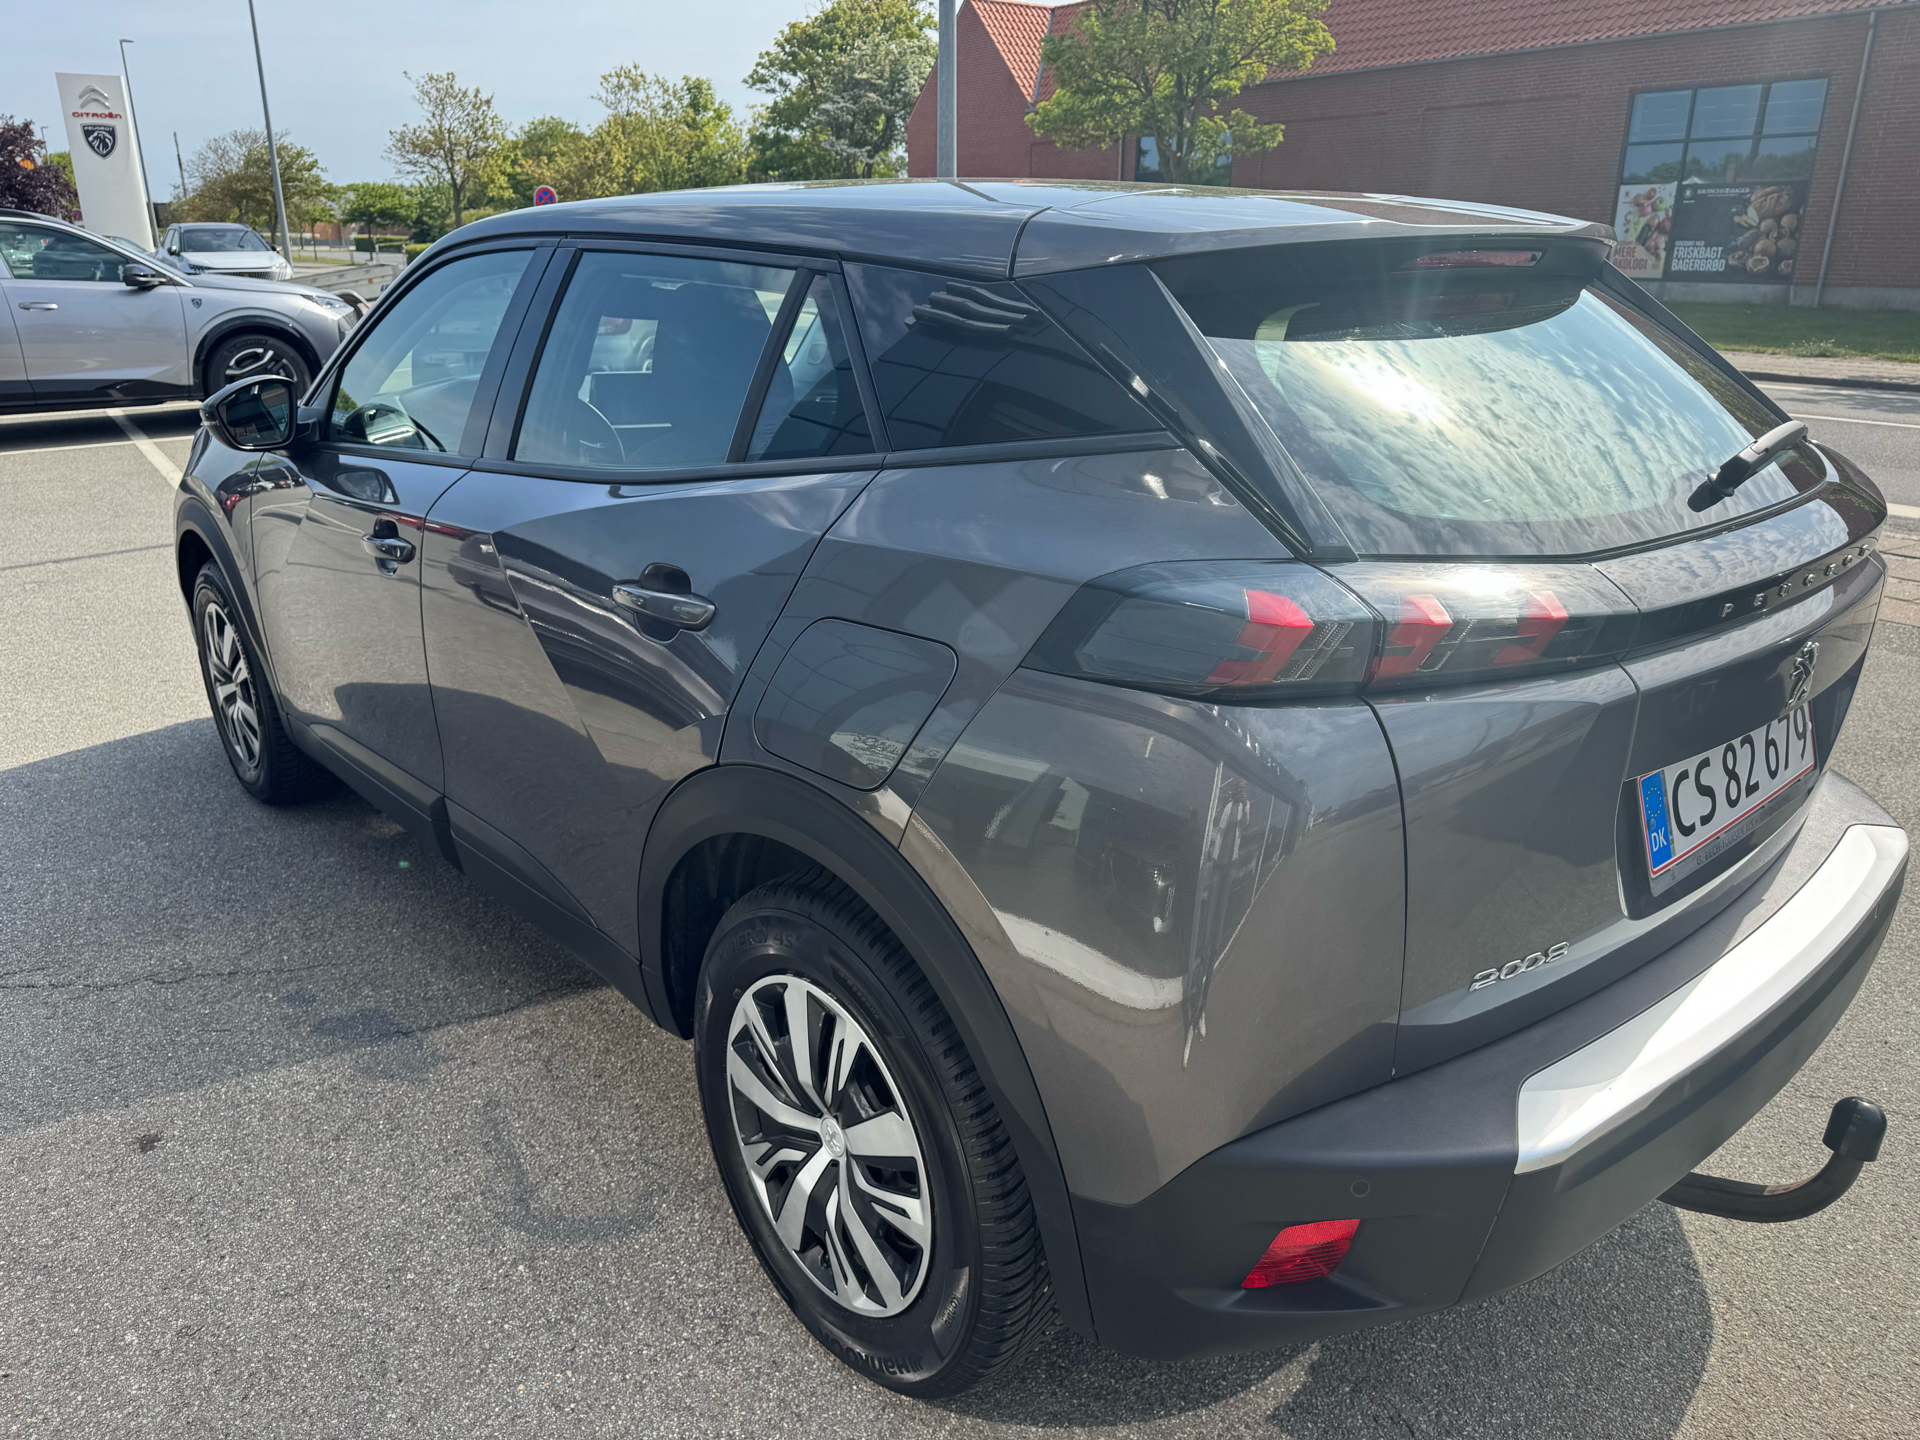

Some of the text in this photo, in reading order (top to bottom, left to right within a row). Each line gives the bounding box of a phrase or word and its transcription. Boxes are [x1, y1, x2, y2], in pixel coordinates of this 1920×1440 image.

[1671, 258, 1726, 271] BAGERBRØD
[1673, 246, 1723, 259] FRISKBAGT
[1719, 544, 1869, 618] PEUGEOT
[1672, 704, 1808, 837] CS 82 679
[1651, 827, 1667, 852] DK
[1468, 941, 1570, 992] 2008
